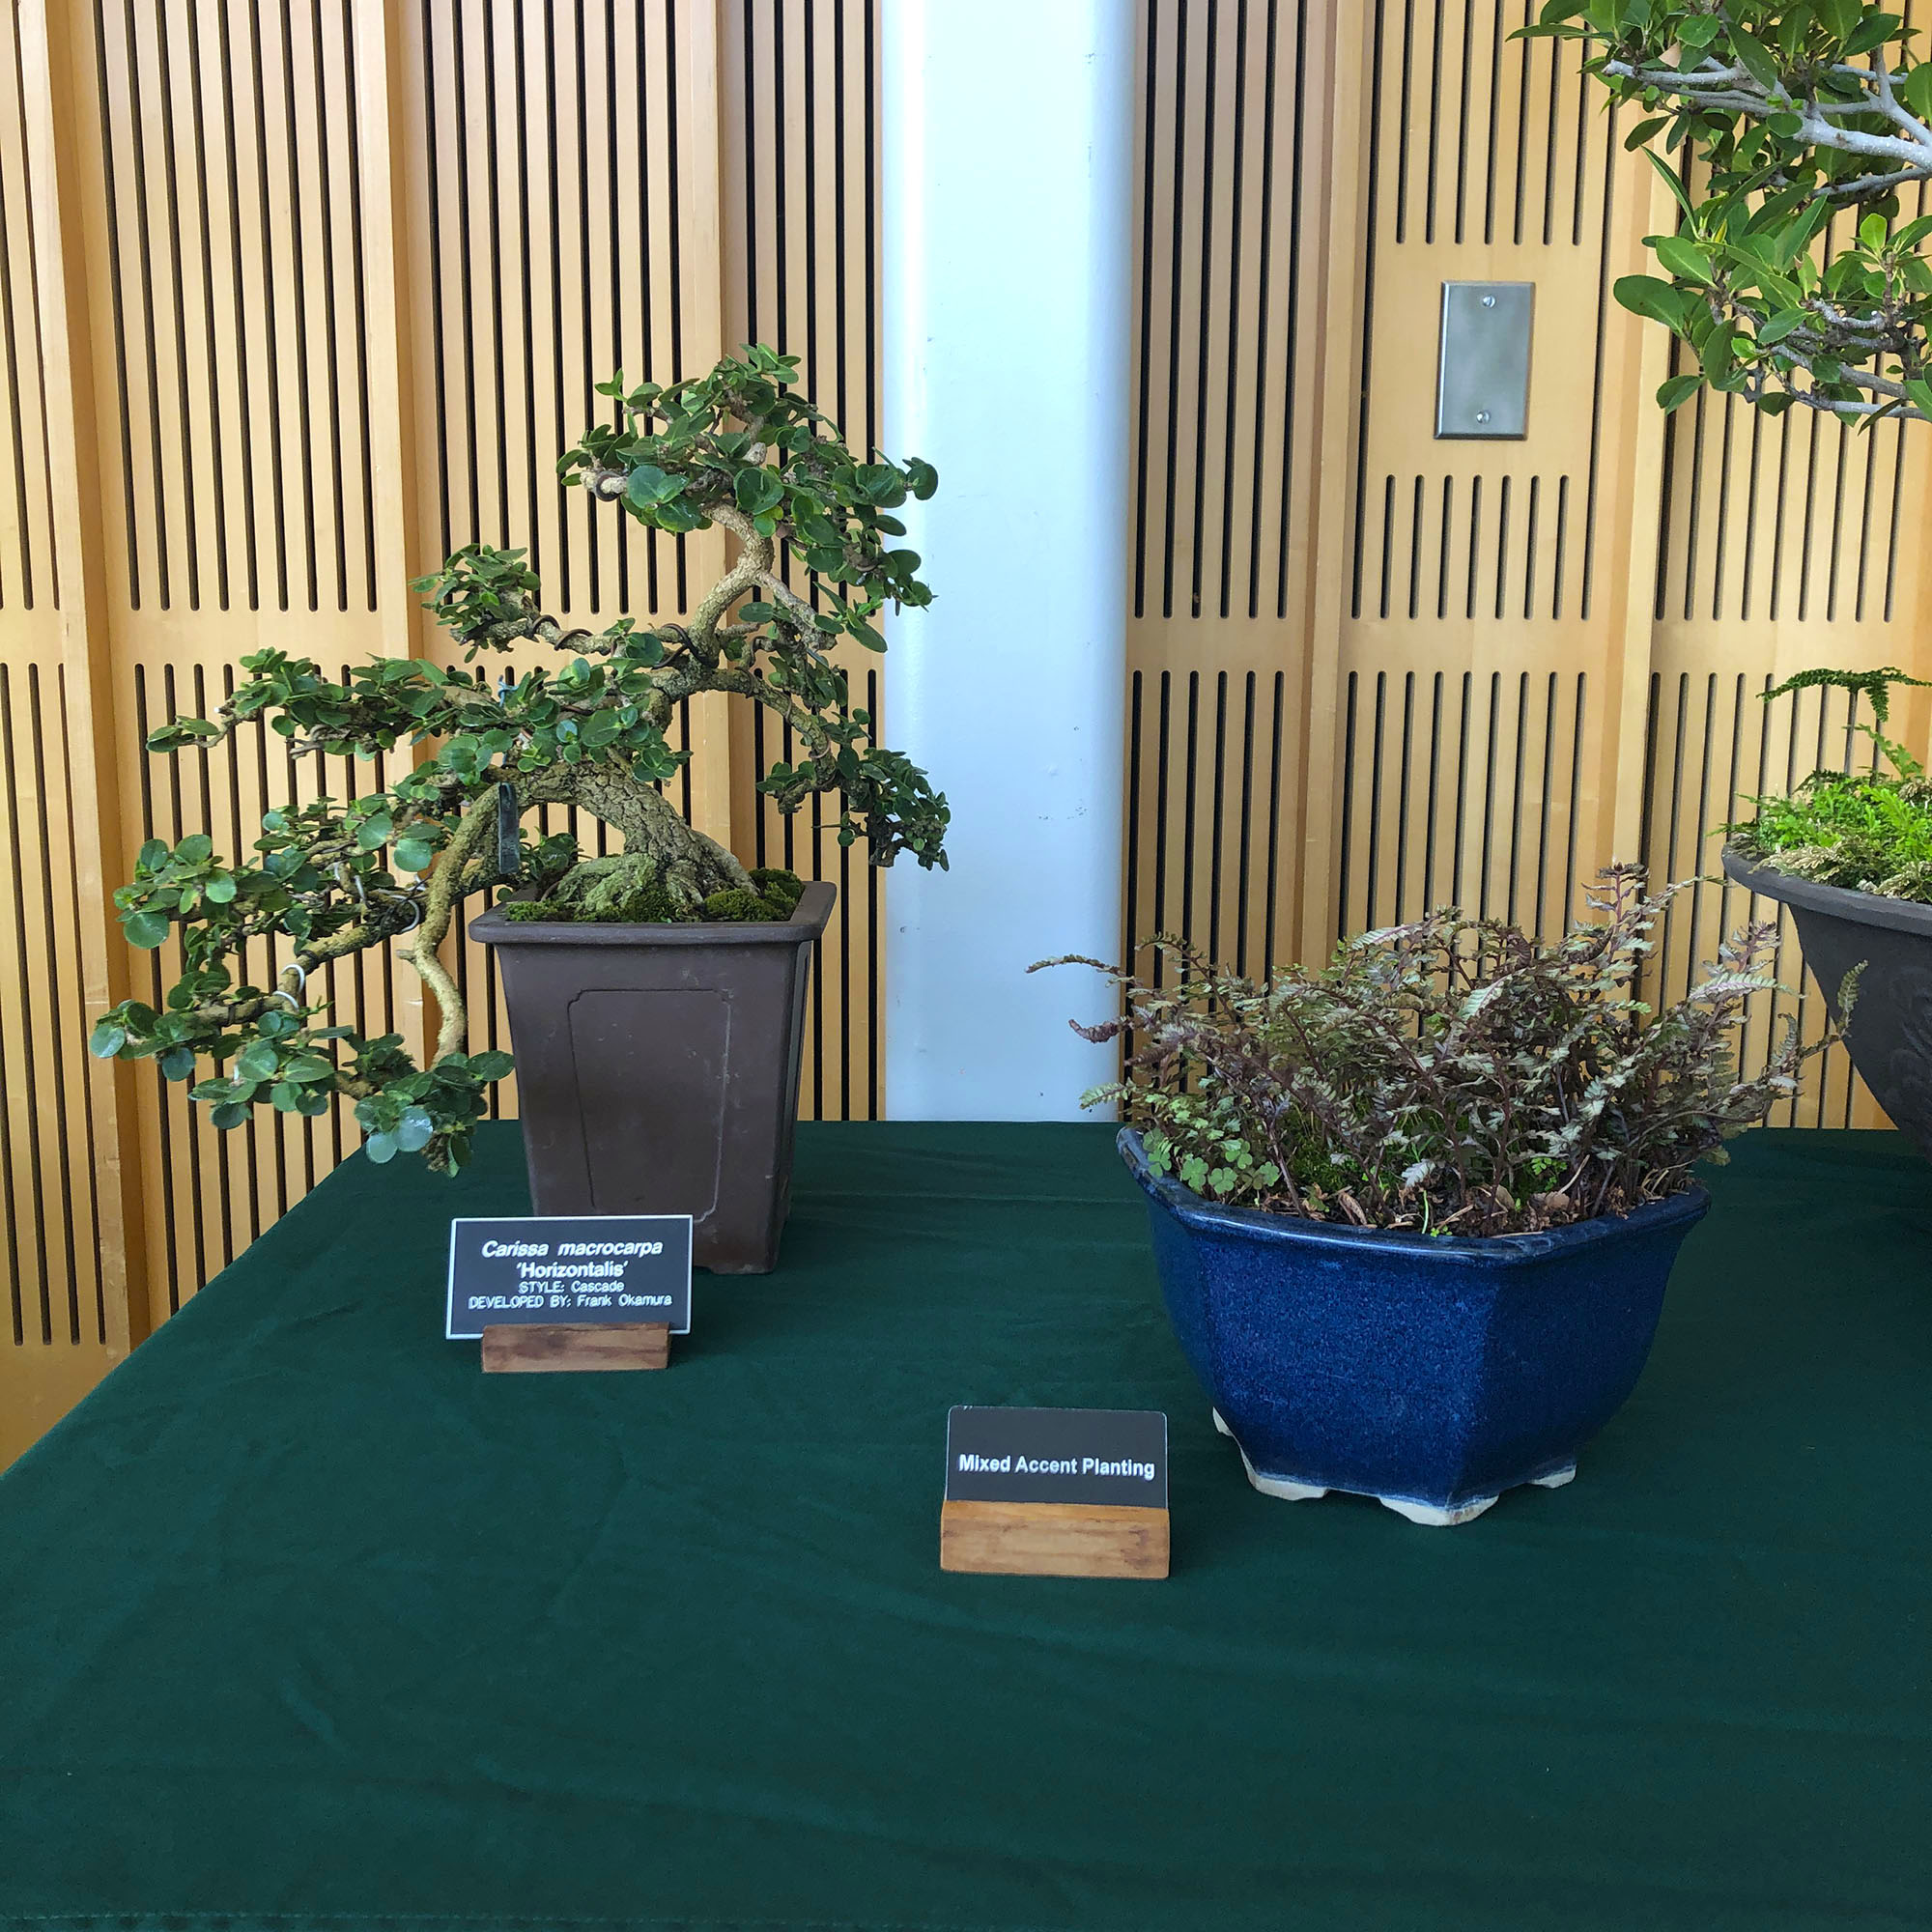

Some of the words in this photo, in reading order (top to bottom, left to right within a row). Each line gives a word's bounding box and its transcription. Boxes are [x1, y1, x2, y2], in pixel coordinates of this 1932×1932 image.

[482, 1240, 549, 1258] Carissa
[557, 1241, 664, 1258] macrocarpa
[518, 1281, 565, 1294] STYLE:
[571, 1280, 625, 1293] Cascade
[469, 1295, 544, 1309] DEVELOPED
[550, 1294, 572, 1308] BY:
[577, 1294, 612, 1307] Frank
[618, 1293, 672, 1306] Okamura
[958, 1454, 1011, 1472] Mixed
[1015, 1456, 1078, 1474] Accent
[1082, 1458, 1155, 1481] Planting
